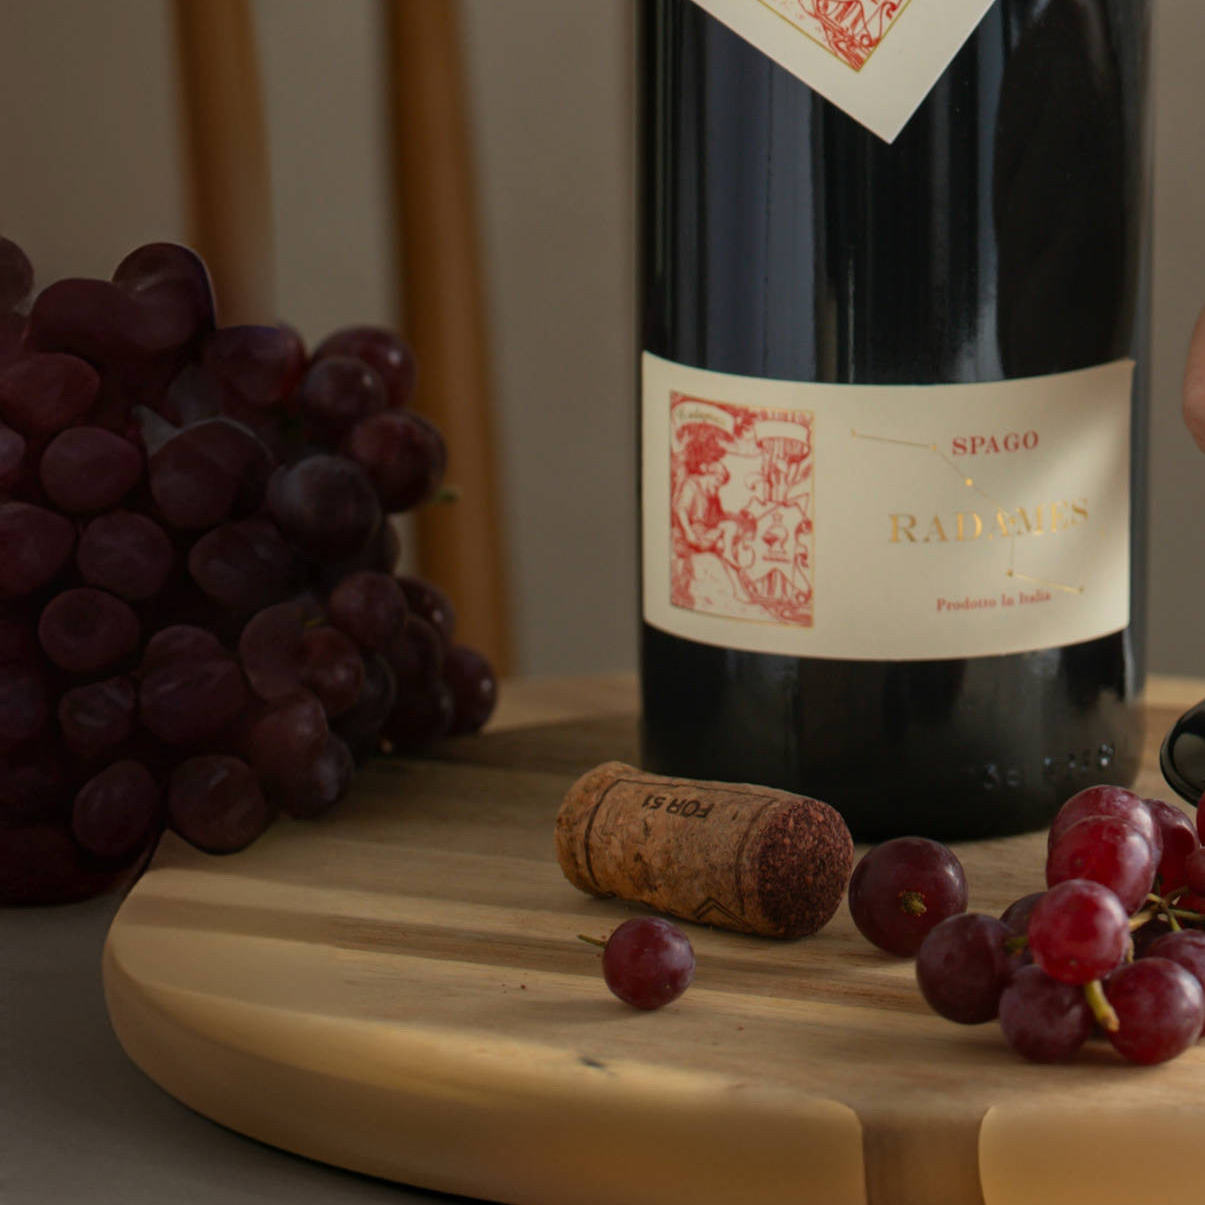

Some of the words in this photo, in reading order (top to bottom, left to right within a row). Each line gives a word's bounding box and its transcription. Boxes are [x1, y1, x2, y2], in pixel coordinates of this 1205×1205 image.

[952, 430, 1039, 457] SPAGO
[889, 498, 1089, 544] RADAMES
[936, 595, 997, 612] Prodotto
